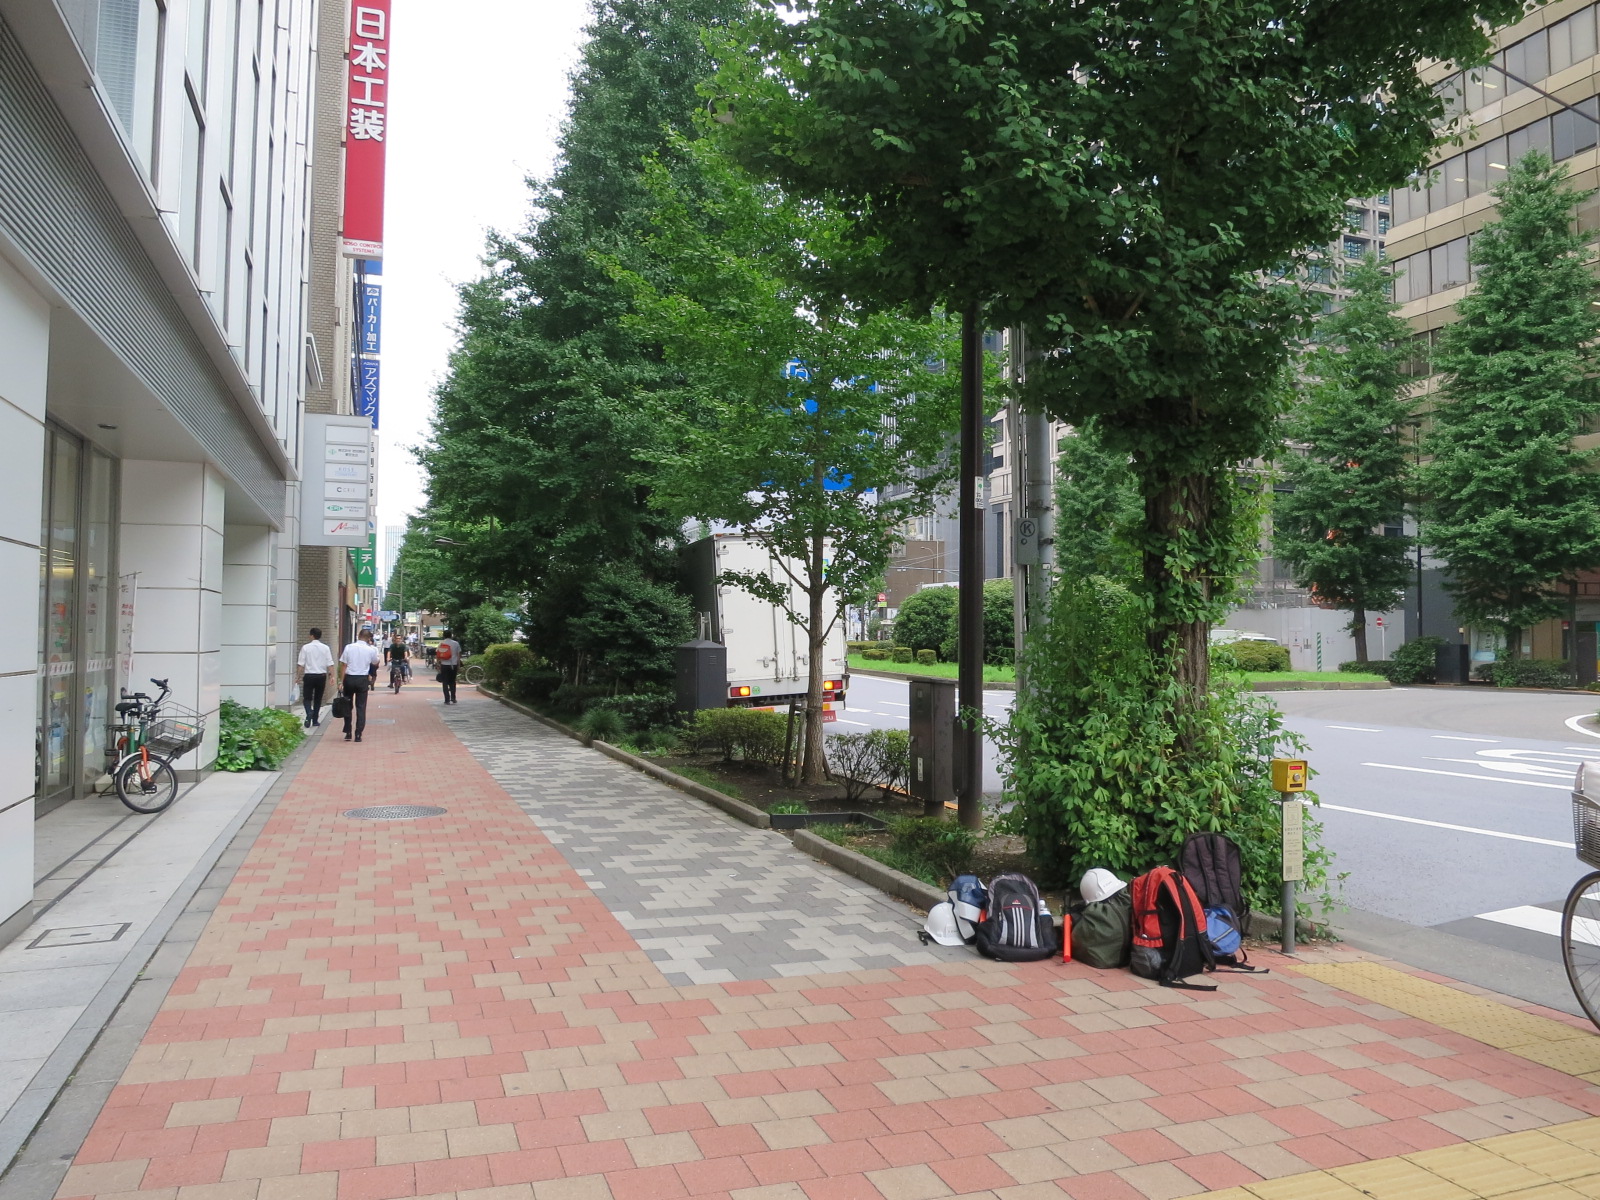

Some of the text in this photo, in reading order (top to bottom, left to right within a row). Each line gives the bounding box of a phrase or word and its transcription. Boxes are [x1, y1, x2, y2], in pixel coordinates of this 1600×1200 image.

[350, 6, 387, 142] 日本工装
[366, 298, 378, 351] パーカー加工
[360, 541, 373, 575] ニチハ
